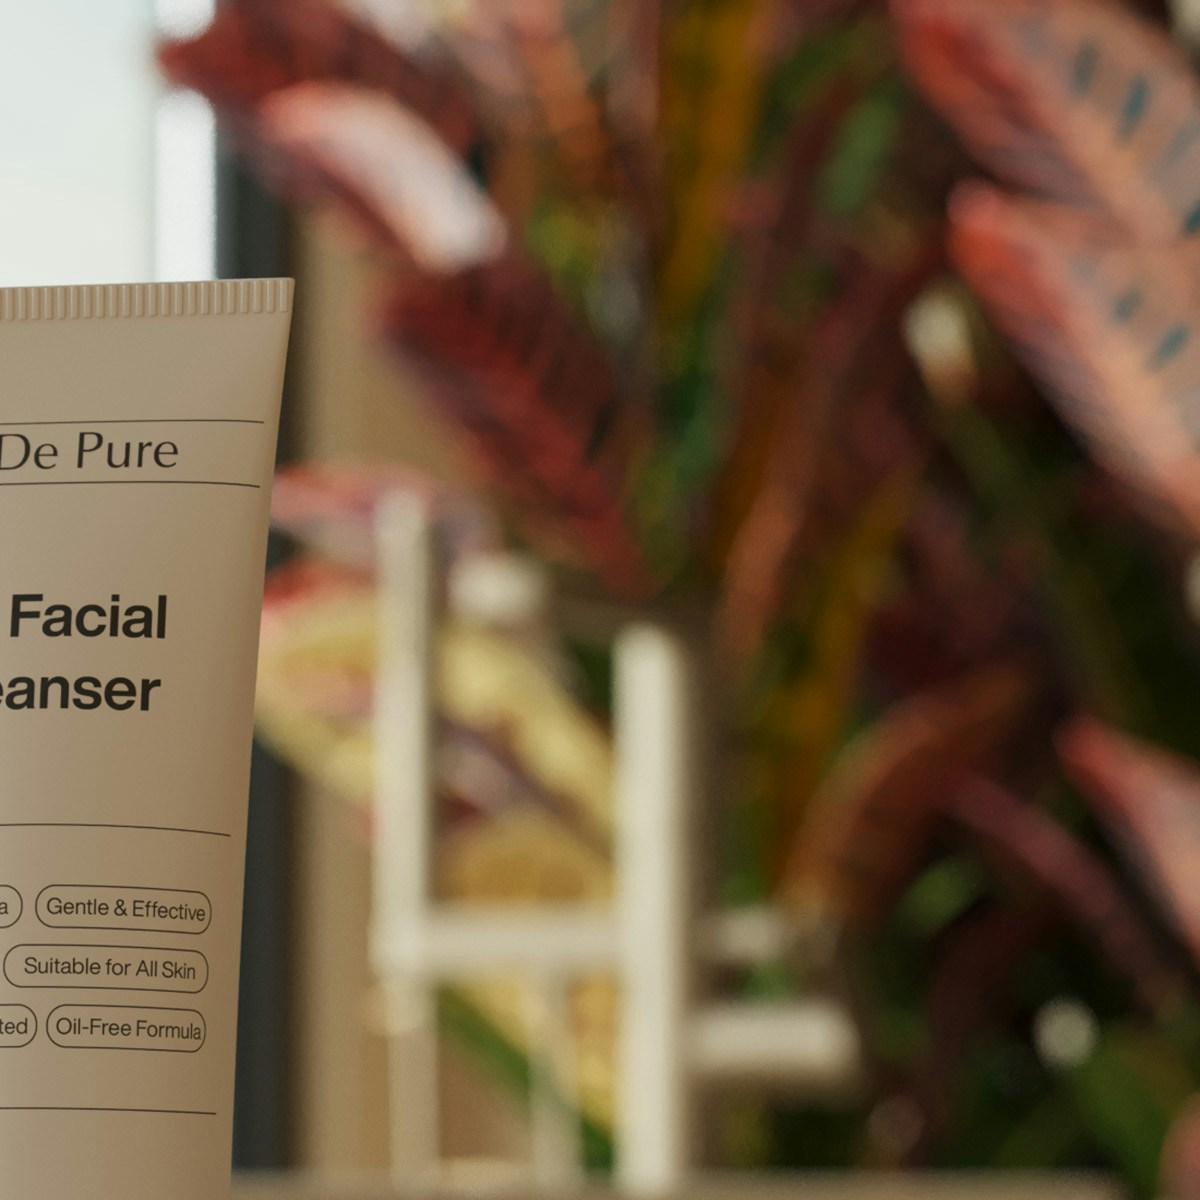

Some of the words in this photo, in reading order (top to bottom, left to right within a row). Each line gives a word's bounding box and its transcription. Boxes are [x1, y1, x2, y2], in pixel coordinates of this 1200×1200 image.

[76, 431, 180, 469] Pure
[9, 594, 168, 640] Facial
[46, 897, 110, 916] Gentle
[113, 899, 128, 917] &
[132, 900, 207, 922] Effective
[24, 957, 101, 976] Suitable
[105, 958, 132, 977] for
[135, 959, 158, 978] All
[161, 961, 196, 981] Skin
[56, 1017, 132, 1037] Oil-Free
[135, 1020, 202, 1041] Formula
